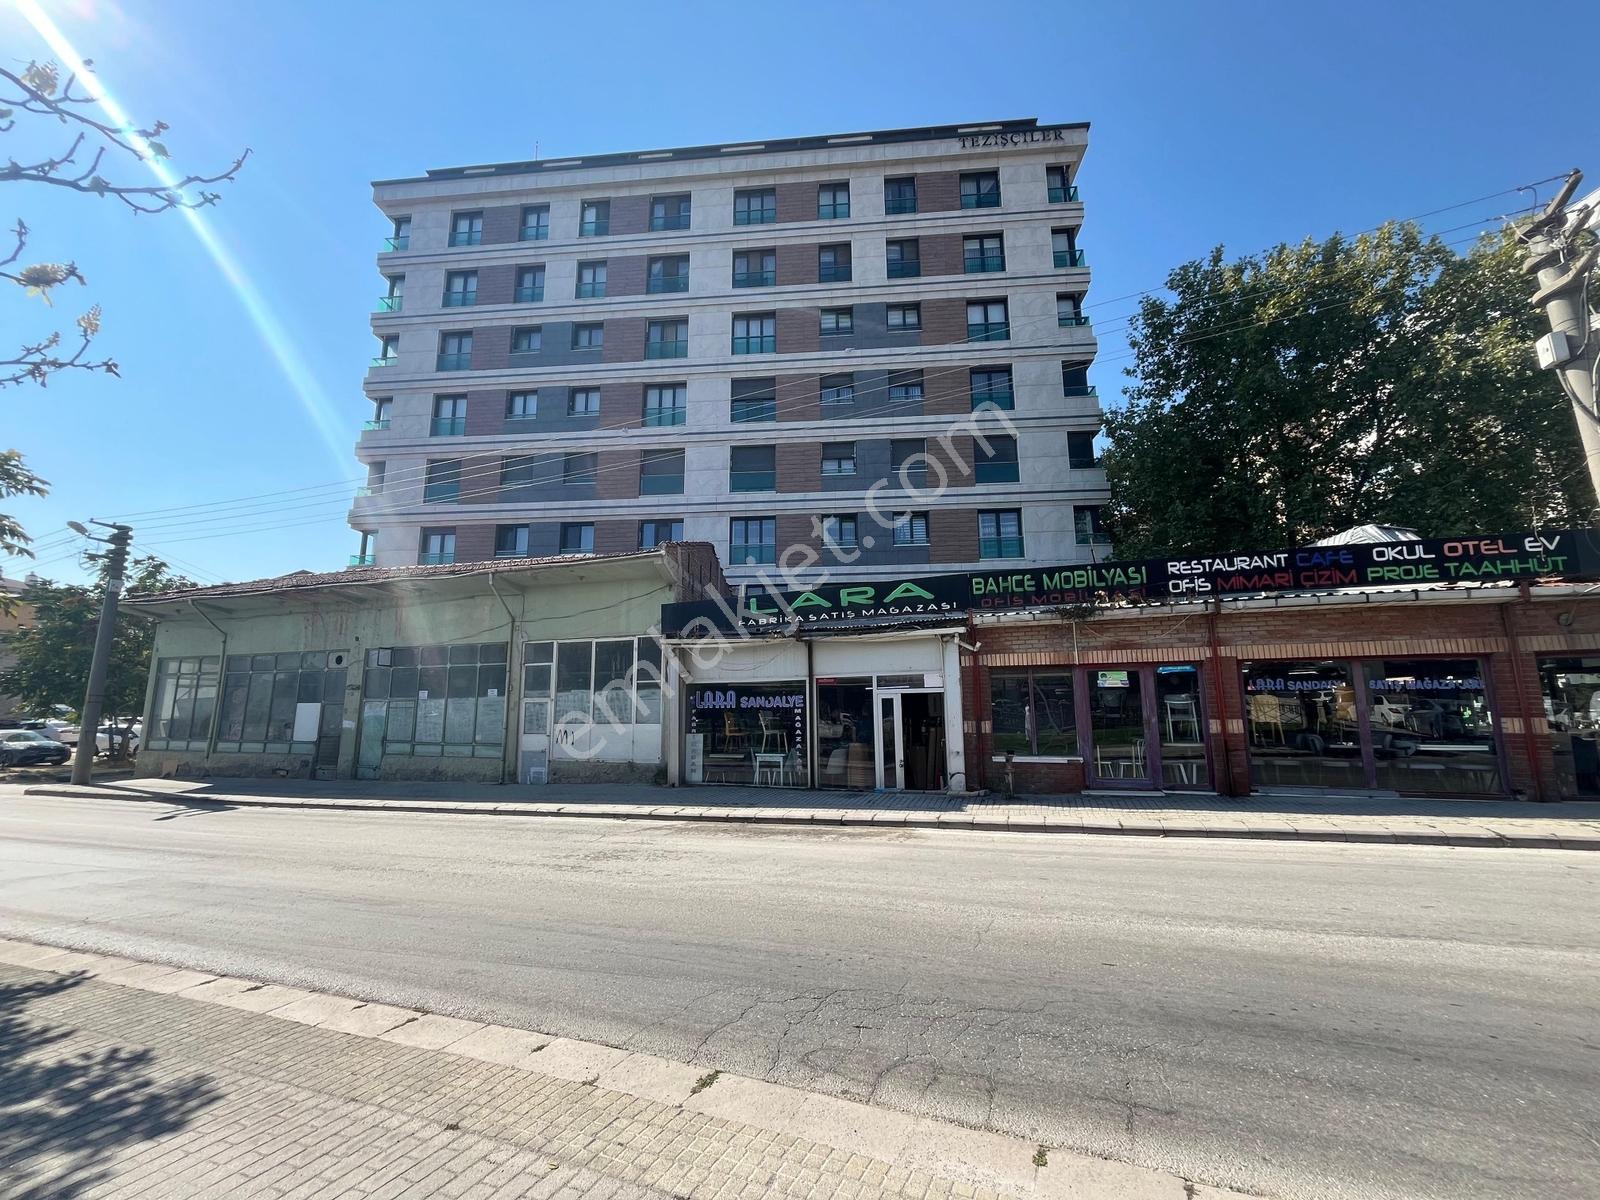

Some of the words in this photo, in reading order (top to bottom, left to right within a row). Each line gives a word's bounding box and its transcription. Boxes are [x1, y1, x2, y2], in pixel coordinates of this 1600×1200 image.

[1167, 553, 1289, 575] RESTAURANT
[1296, 550, 1354, 567] CAFE
[1372, 544, 1436, 562] OKUL
[1443, 539, 1518, 557] OTEL
[1524, 535, 1561, 552] EV
[1042, 565, 1148, 591] MOBİLYASI
[1168, 575, 1212, 593] OFİS
[1216, 569, 1294, 592] MİMARİ
[1300, 567, 1358, 588] ÇİZİM
[1366, 564, 1440, 582] PROJE
[1443, 555, 1569, 577] TAAHHÜT
[750, 582, 935, 614] LARA
[809, 610, 856, 622] SATIŞ
[1287, 679, 1346, 691] SANDALY
[695, 690, 737, 709] LARA
[740, 695, 804, 709] SANDALYE
